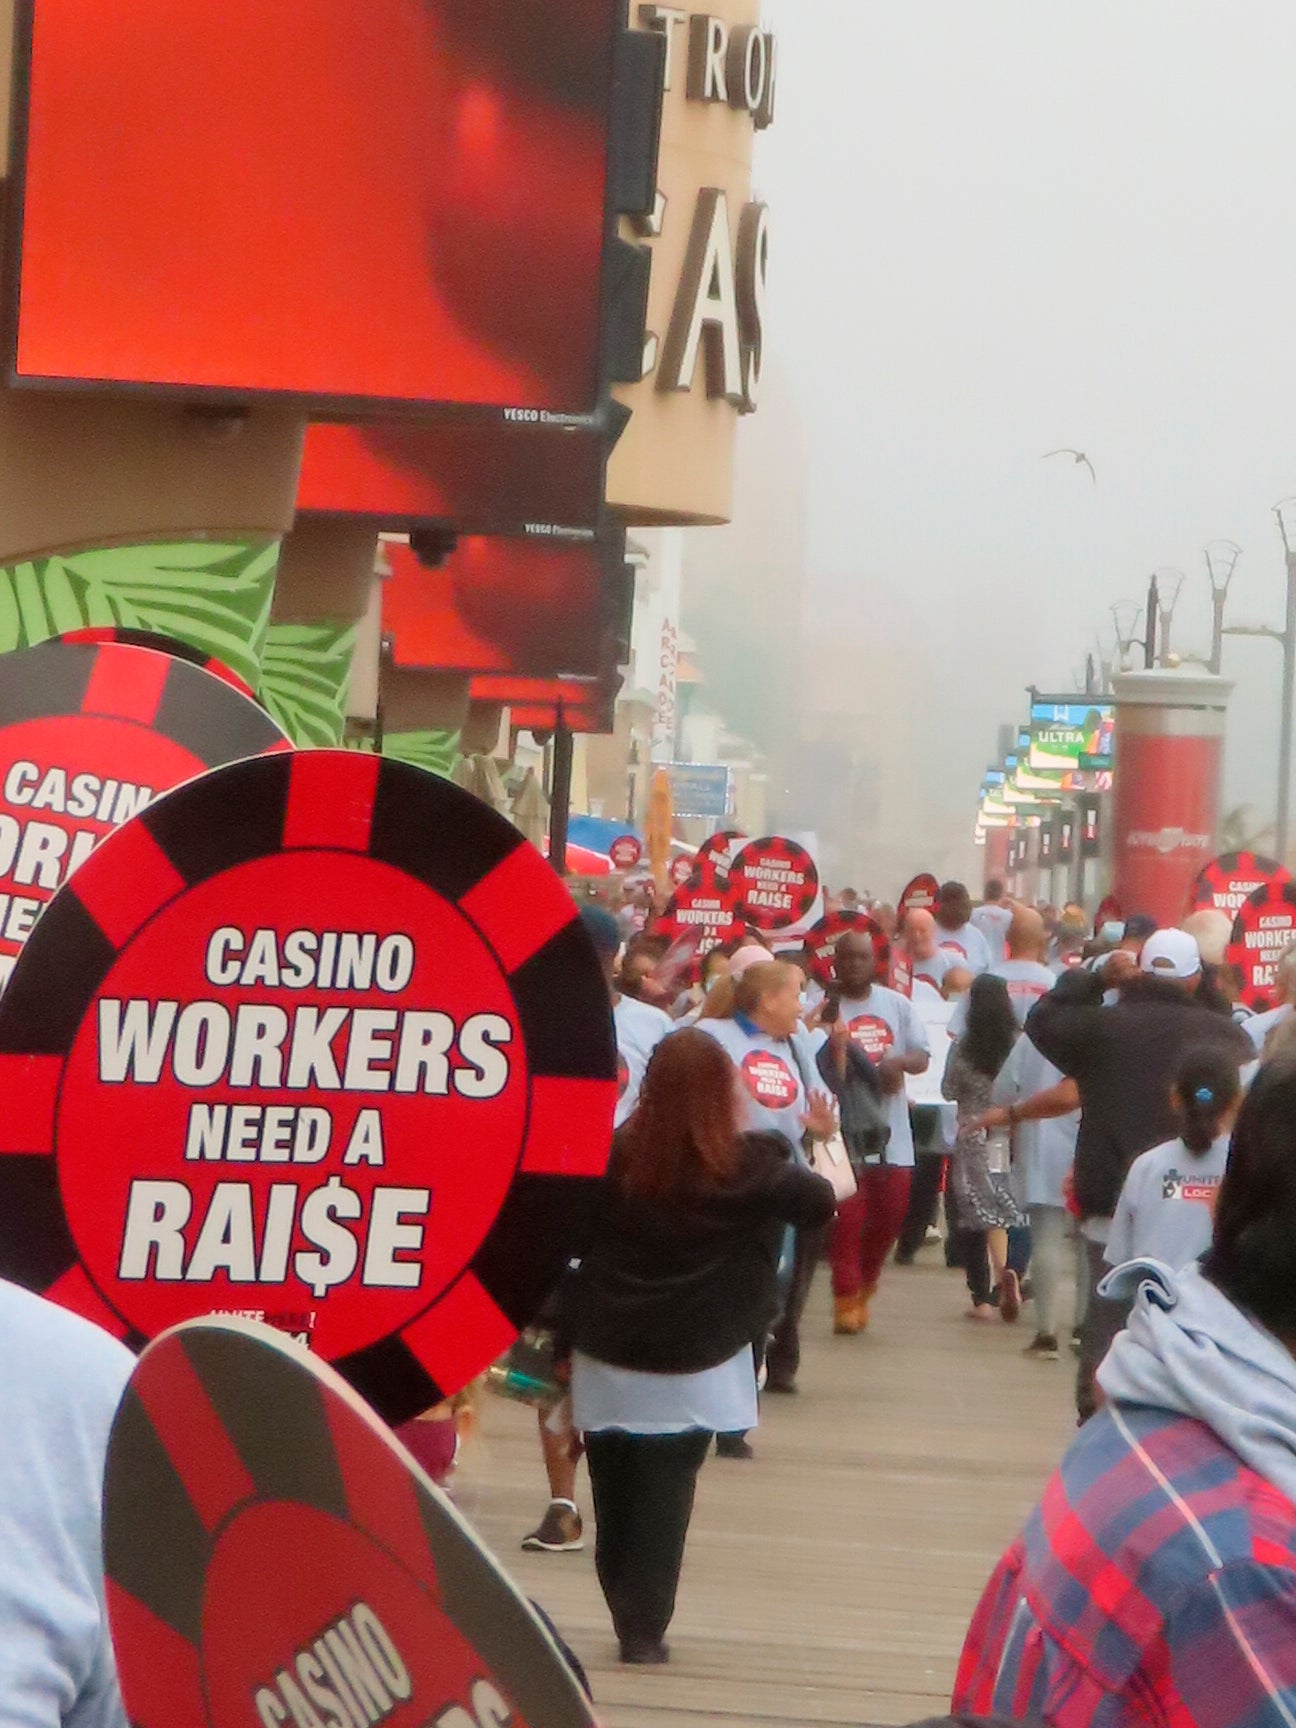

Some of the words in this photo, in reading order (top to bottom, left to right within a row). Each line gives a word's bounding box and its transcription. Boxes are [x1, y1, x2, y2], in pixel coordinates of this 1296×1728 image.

[1038, 730, 1084, 744] ULTRA
[4, 760, 167, 826] CASIN
[205, 927, 414, 993] CASINO
[97, 997, 513, 1099] WORKERS
[184, 1104, 333, 1165] NEED
[343, 1108, 384, 1166] A
[117, 1175, 431, 1299] RAI$E
